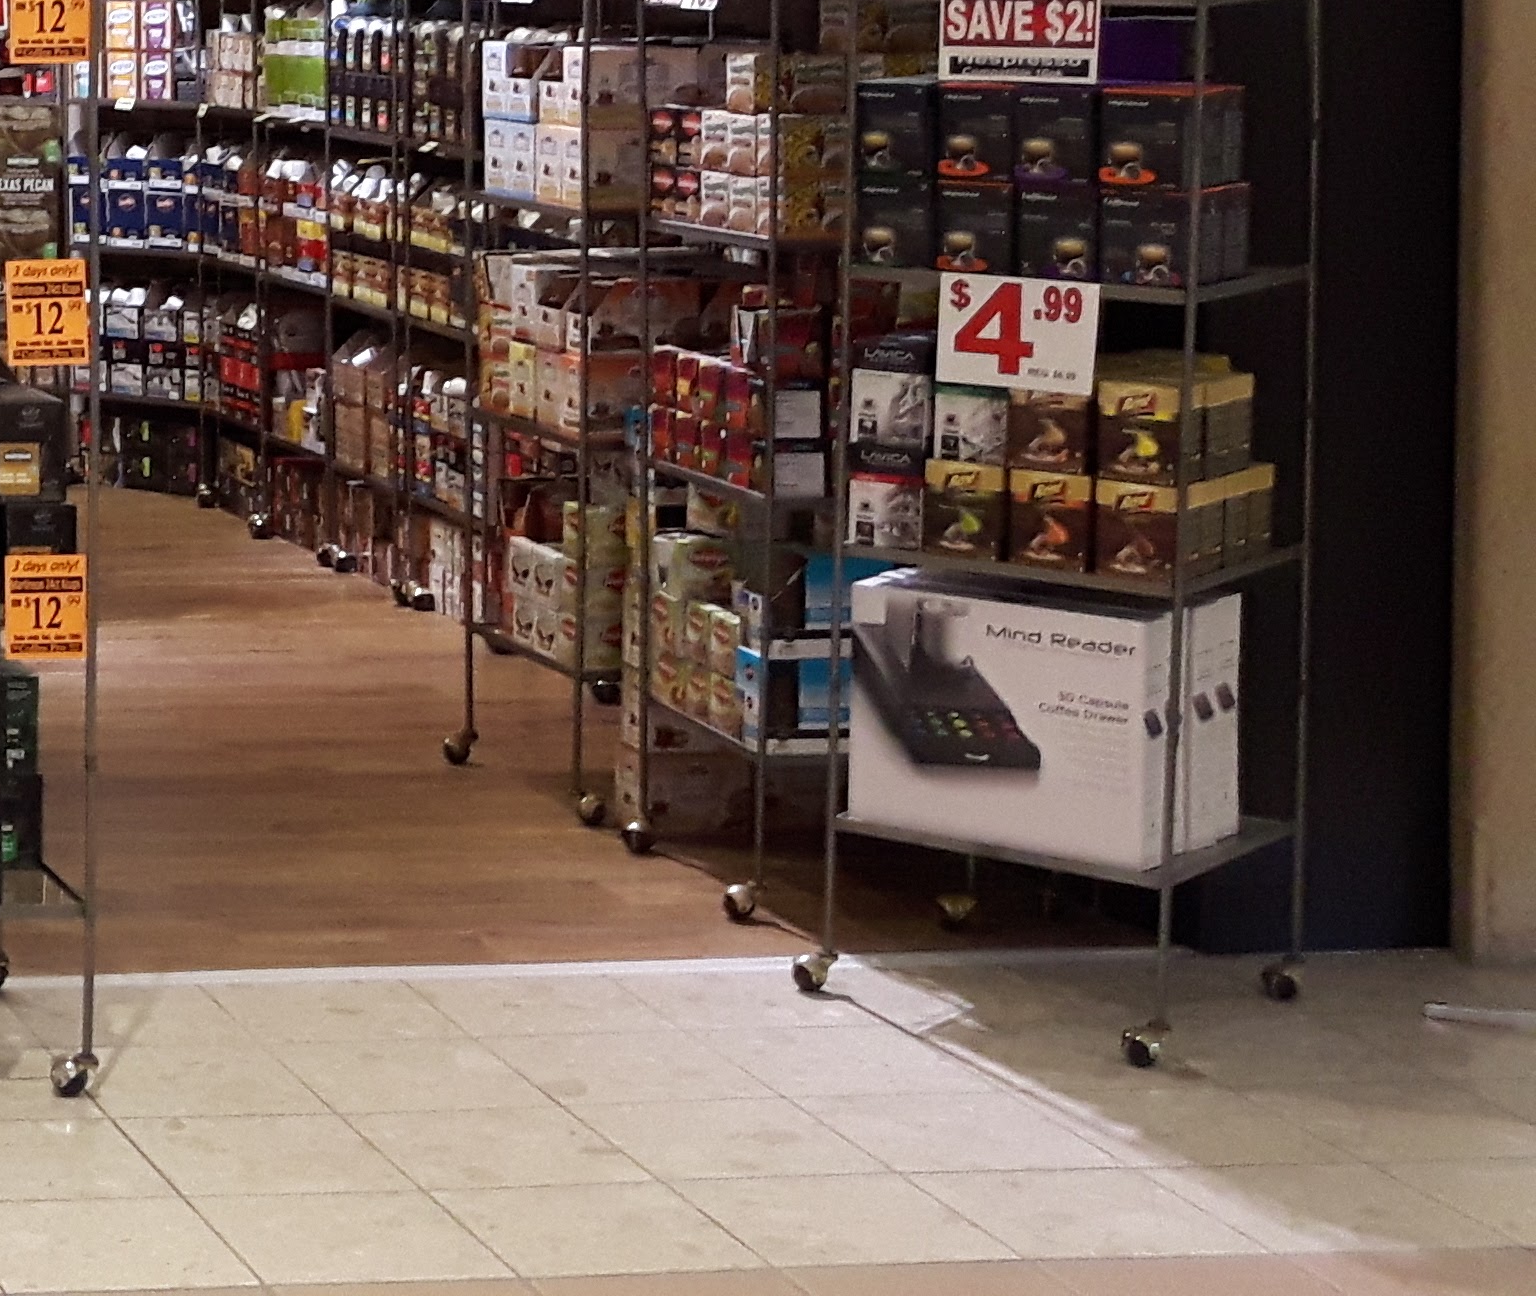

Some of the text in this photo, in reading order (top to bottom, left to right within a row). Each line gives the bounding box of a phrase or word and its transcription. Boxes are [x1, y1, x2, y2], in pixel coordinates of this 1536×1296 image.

[949, 278, 1083, 376] $4.99
[985, 623, 1136, 657] Mind Reader
